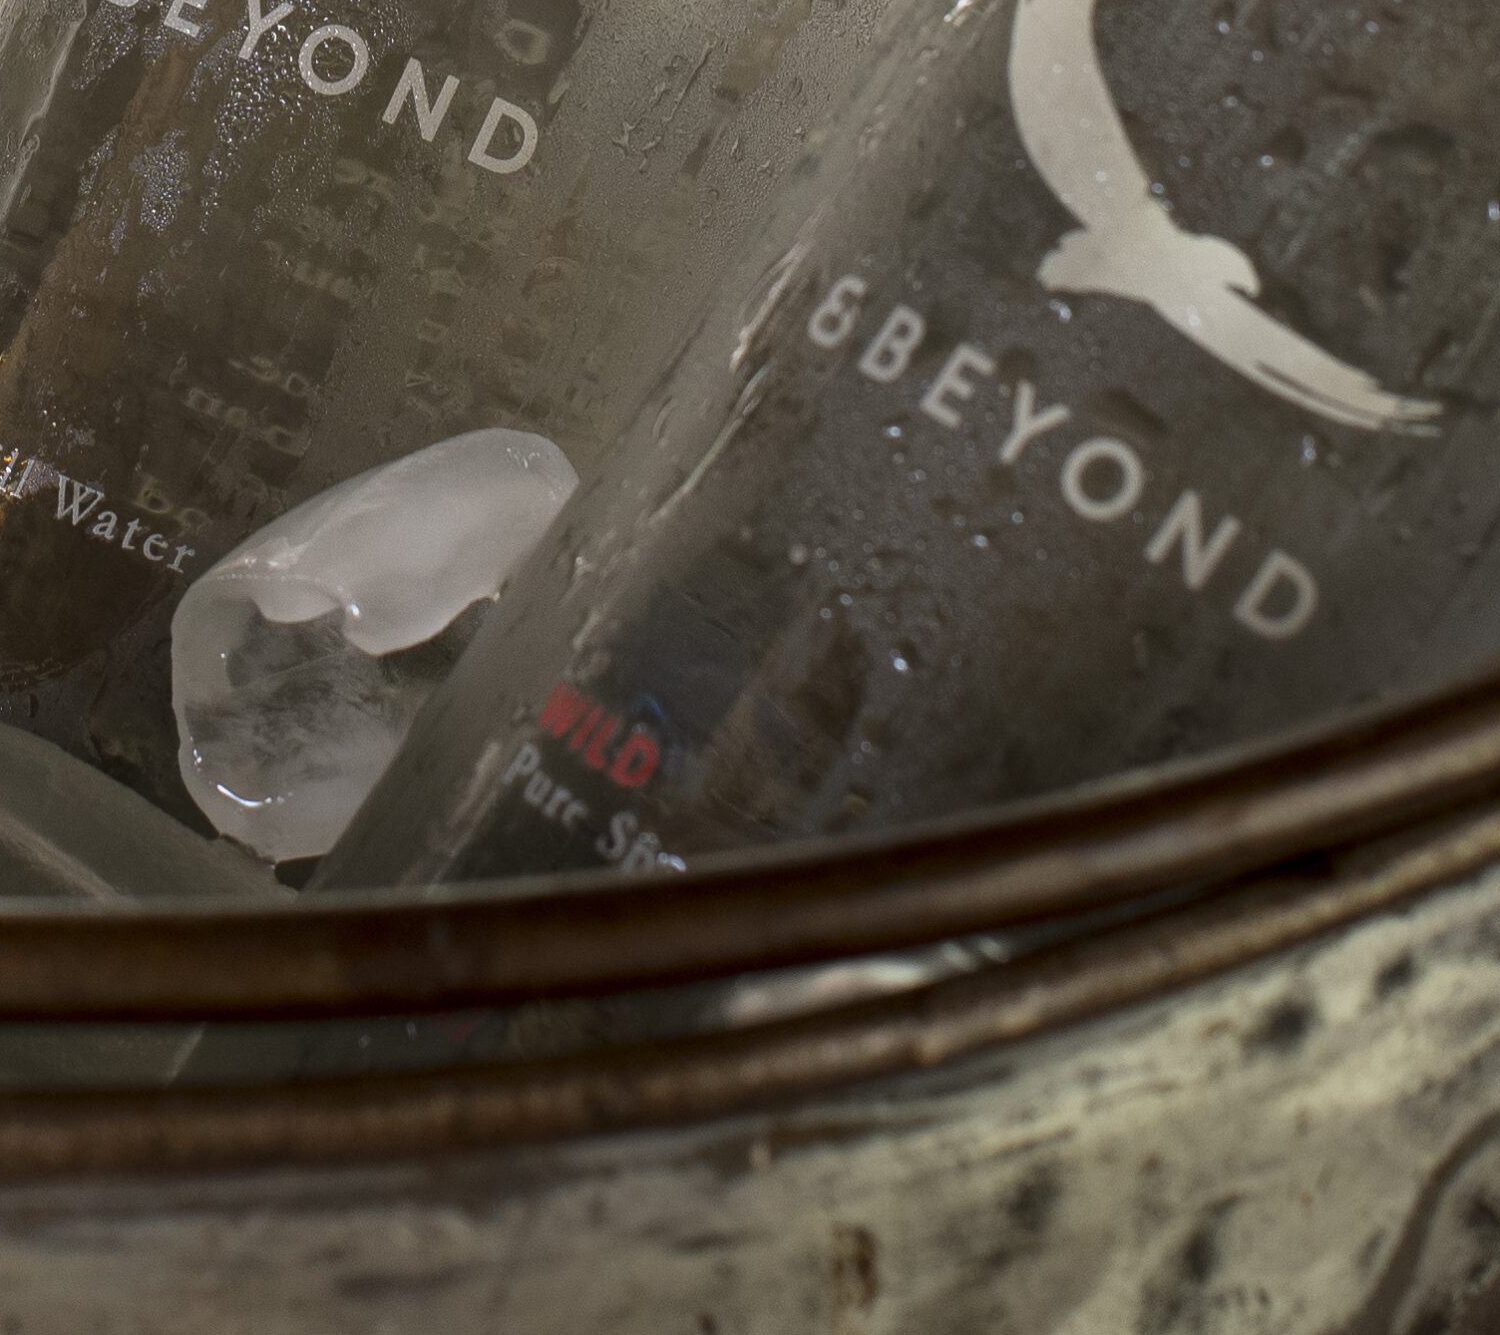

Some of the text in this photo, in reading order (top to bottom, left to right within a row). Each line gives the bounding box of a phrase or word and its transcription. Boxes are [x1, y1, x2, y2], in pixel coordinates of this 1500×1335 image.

[55, 473, 194, 574] Water
[502, 742, 588, 827] Pure
[540, 680, 660, 788] WILD
